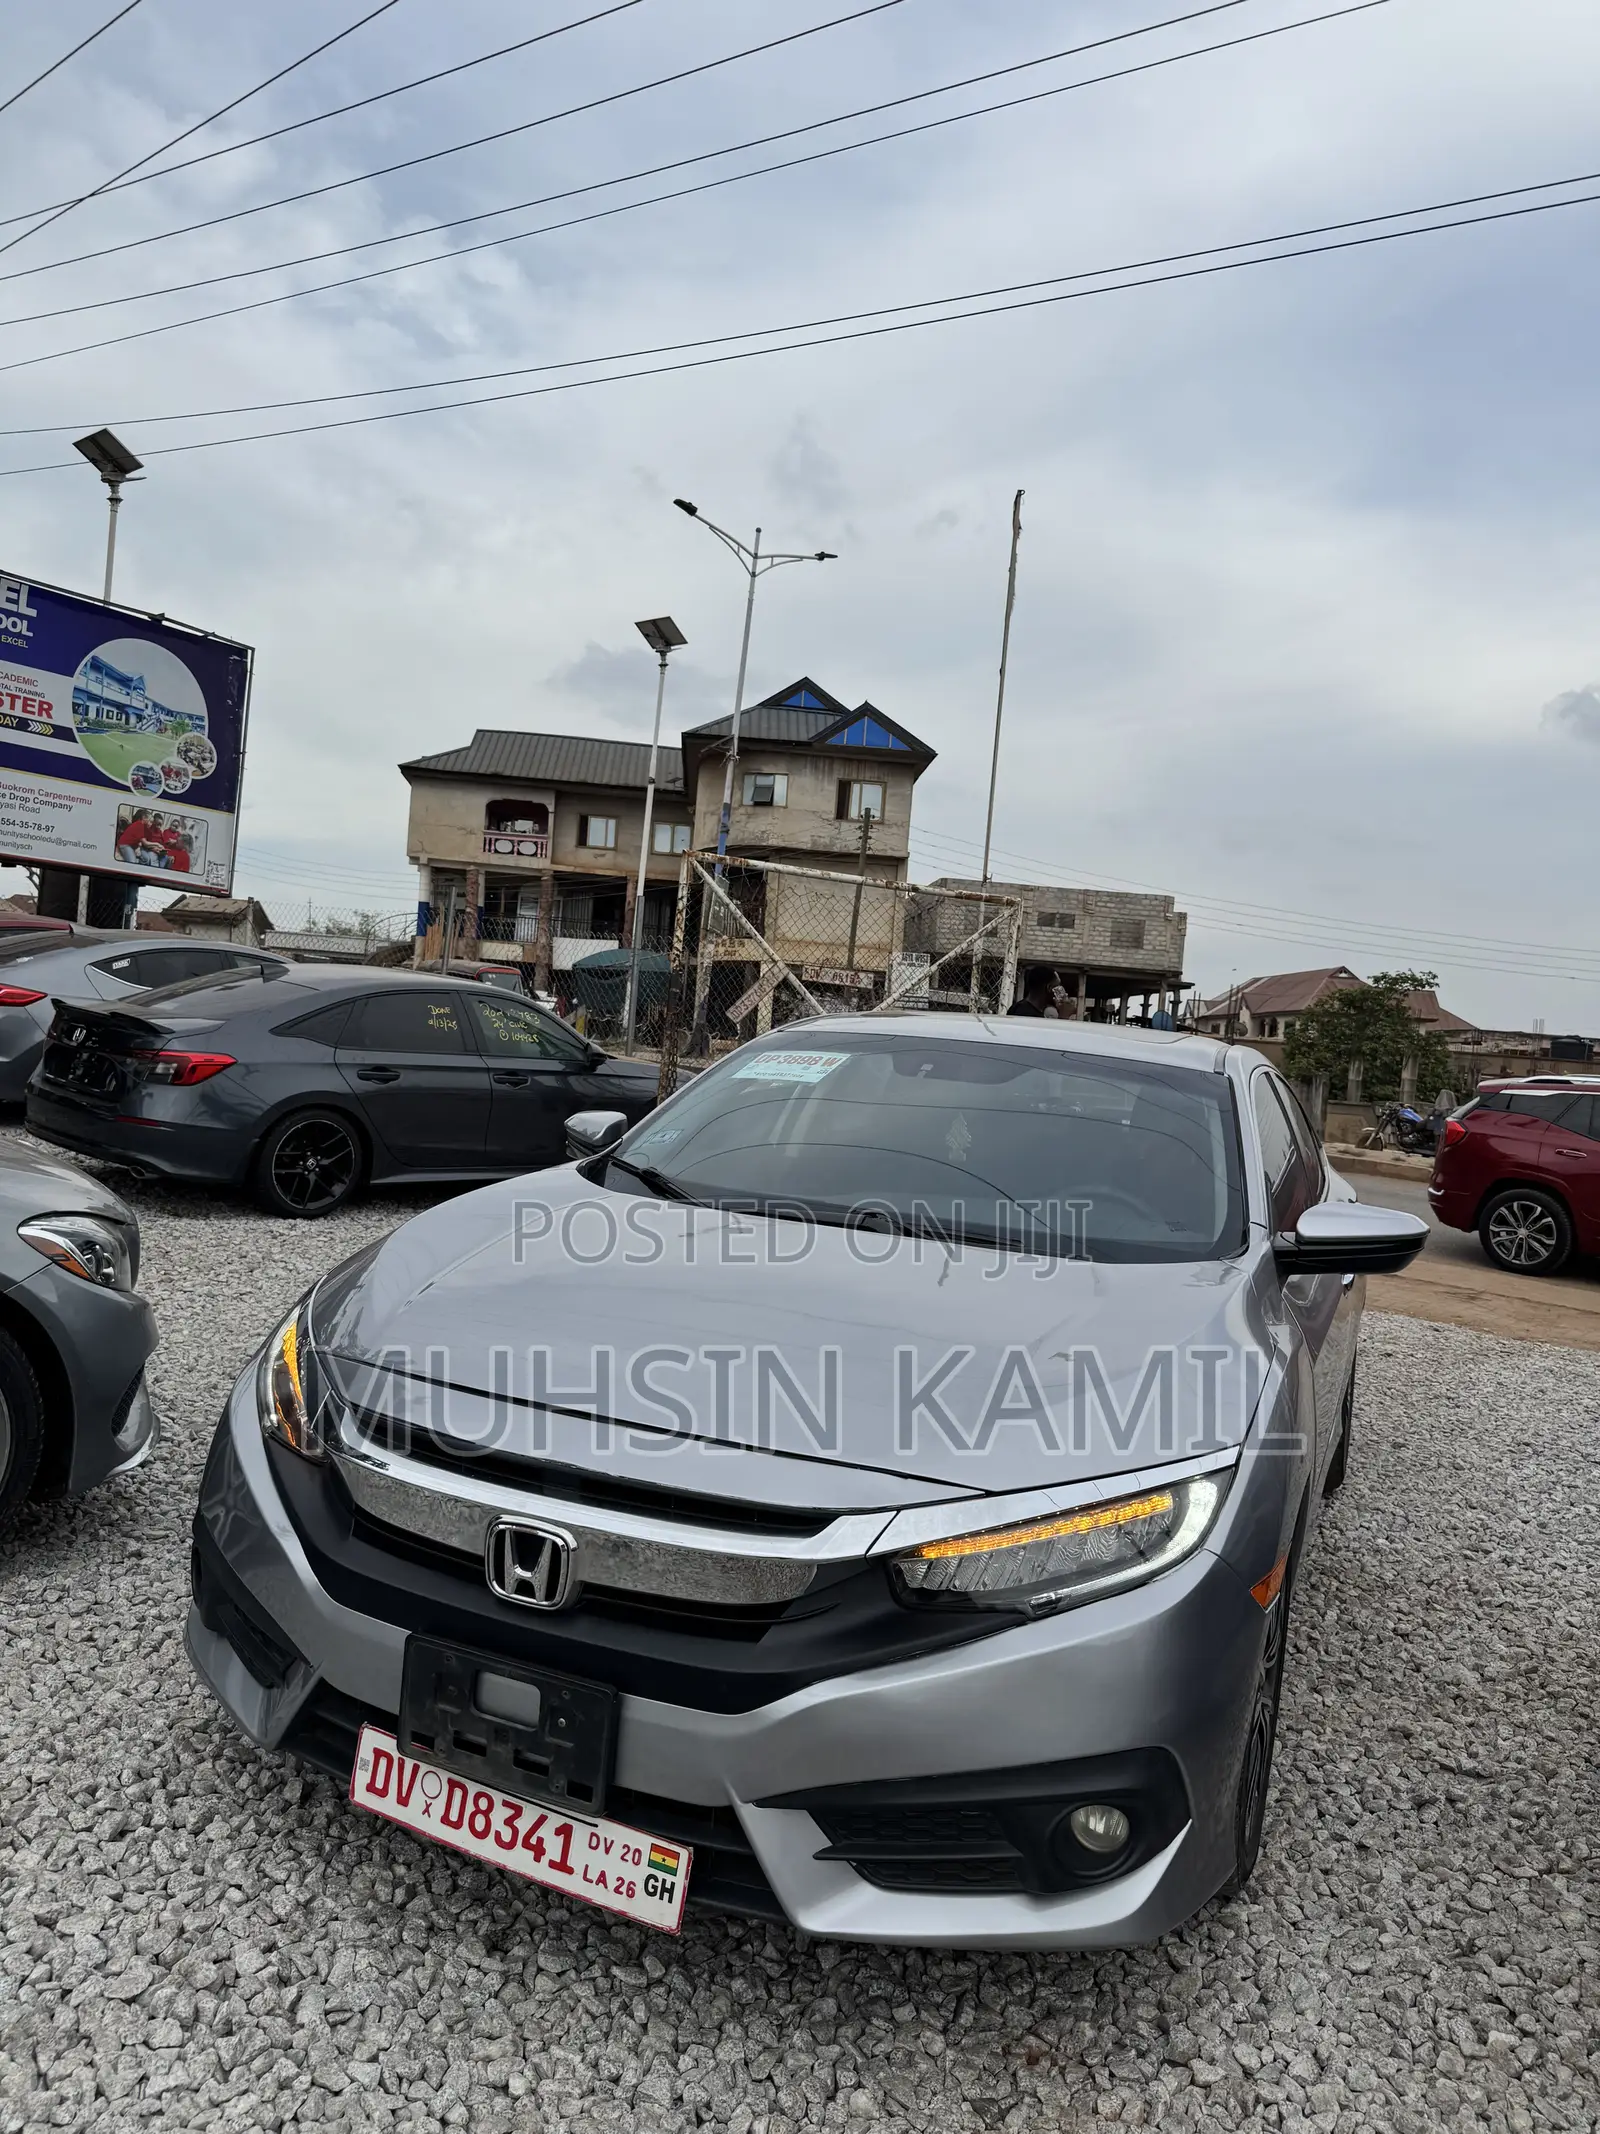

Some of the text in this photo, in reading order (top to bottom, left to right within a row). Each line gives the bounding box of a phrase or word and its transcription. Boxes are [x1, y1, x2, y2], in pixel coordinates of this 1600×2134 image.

[1, 634, 29, 649] EXCEL
[14, 686, 46, 699] TRAINING
[9, 792, 31, 804] Drop
[33, 796, 74, 813] Company
[38, 788, 93, 806] Carpentermu
[18, 803, 41, 815] Road
[1, 817, 55, 834] 554-35-78-97
[427, 1004, 451, 1015] DONE
[588, 1831, 643, 1867] DV 20
[582, 1863, 637, 1900] LA 26
[643, 1872, 677, 1905] GH
